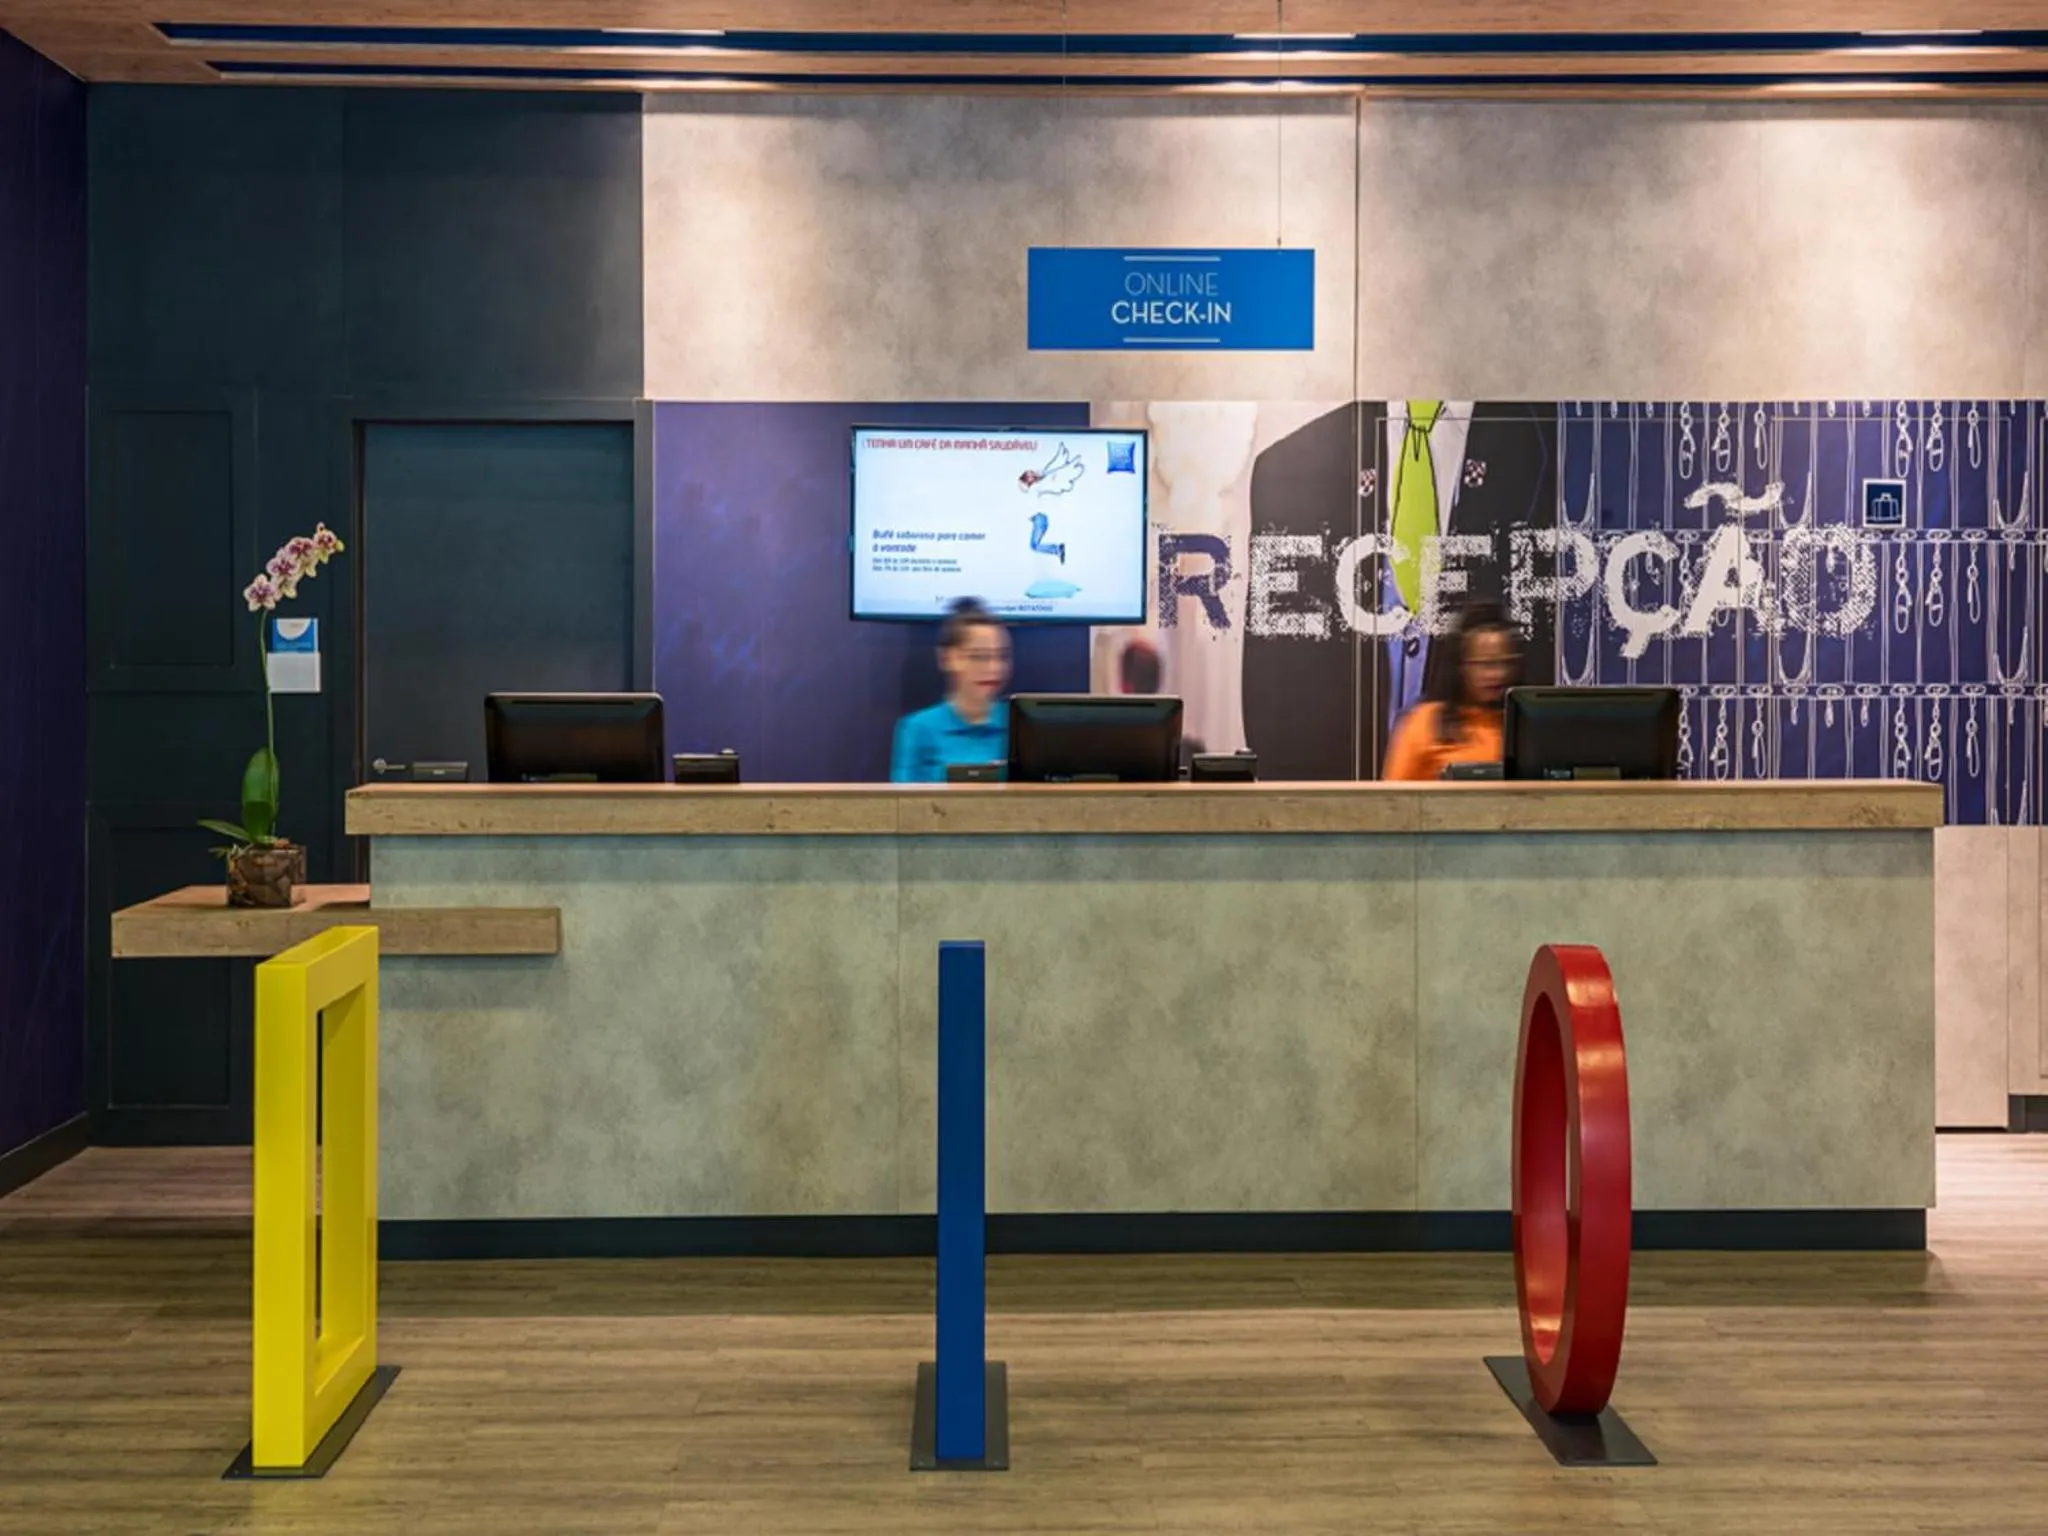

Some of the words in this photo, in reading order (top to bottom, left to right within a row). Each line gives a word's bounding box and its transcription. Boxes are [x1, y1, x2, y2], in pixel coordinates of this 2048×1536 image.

[1124, 272, 1219, 296] ONLINE
[1111, 300, 1232, 324] CHECK-IN
[898, 438, 913, 449] UM
[914, 437, 937, 450] CAFÉ
[939, 438, 952, 450] DA
[954, 437, 988, 450] MANHÃ
[937, 532, 956, 542] para
[958, 532, 986, 541] comer
[880, 543, 917, 553] vontade
[1156, 481, 1878, 660] RECEPÇÃO
